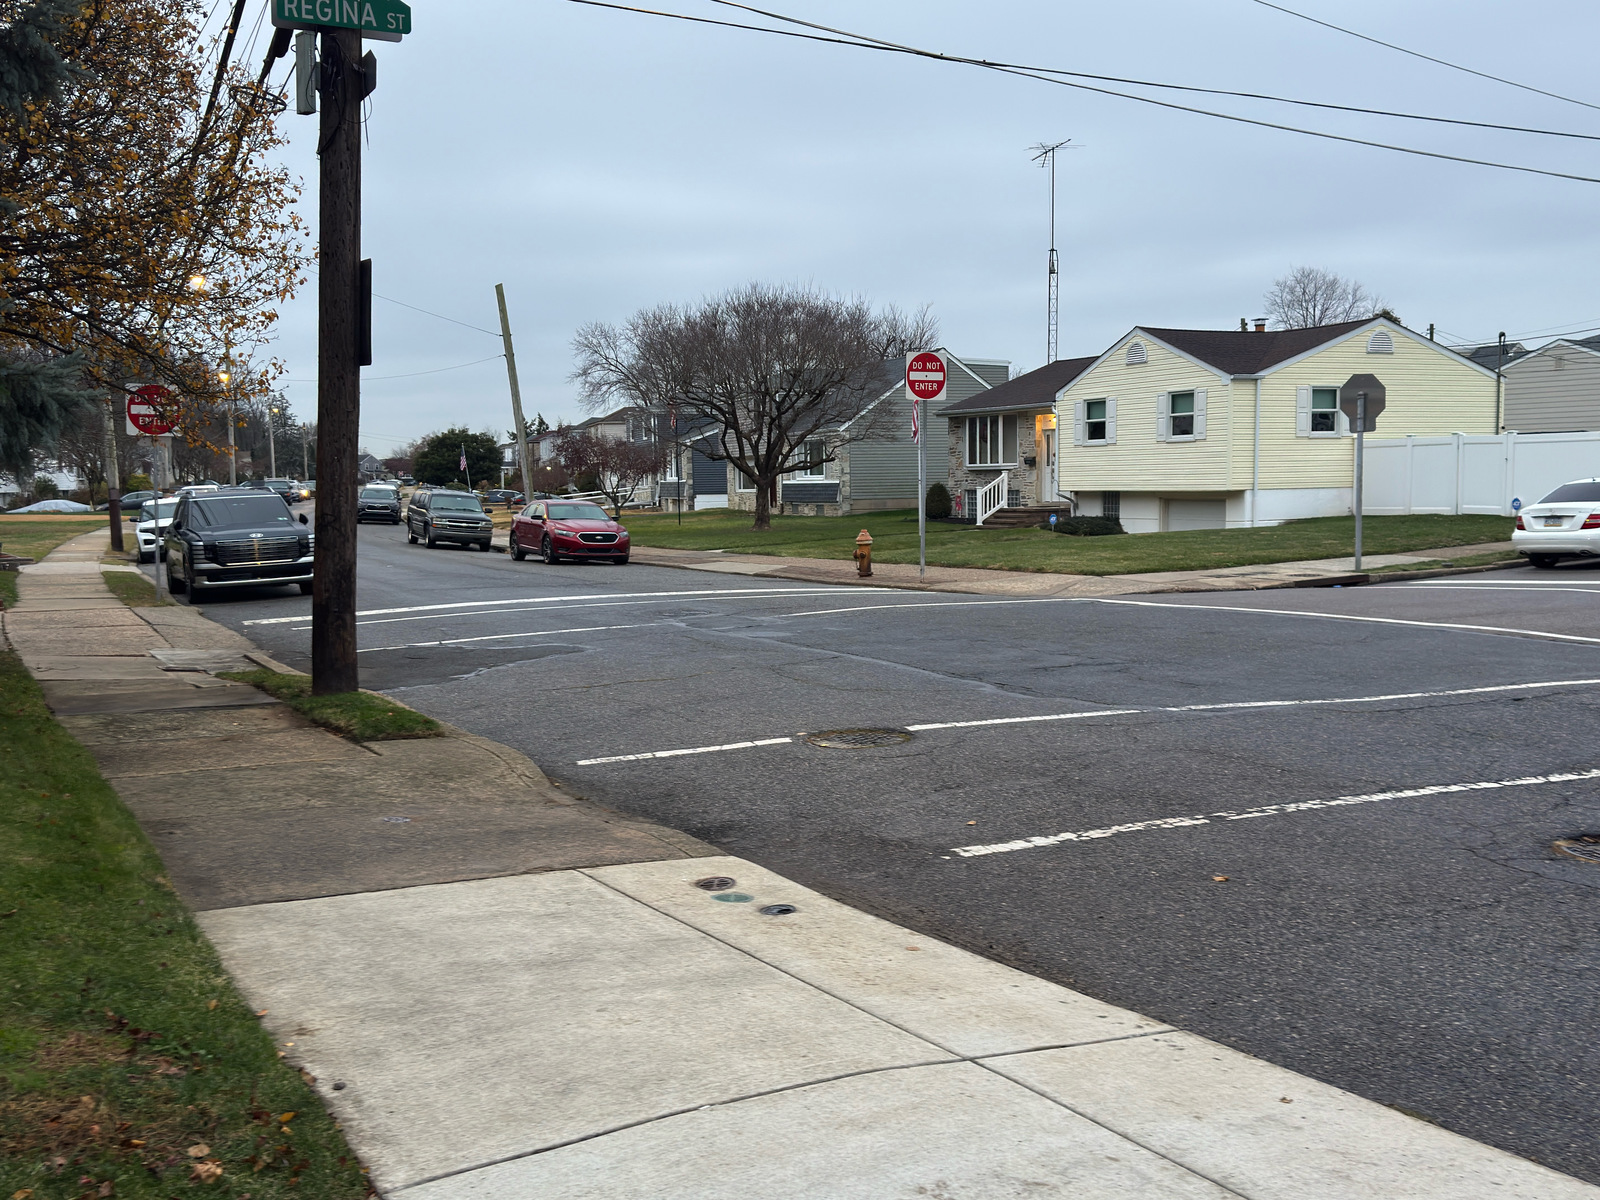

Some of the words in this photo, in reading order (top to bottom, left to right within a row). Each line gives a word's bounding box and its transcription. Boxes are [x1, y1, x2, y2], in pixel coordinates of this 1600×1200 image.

[284, 0, 377, 27] REGINA
[386, 12, 405, 30] ST
[912, 361, 923, 370] DO
[926, 361, 941, 370] NOT
[915, 382, 938, 391] ENTER
